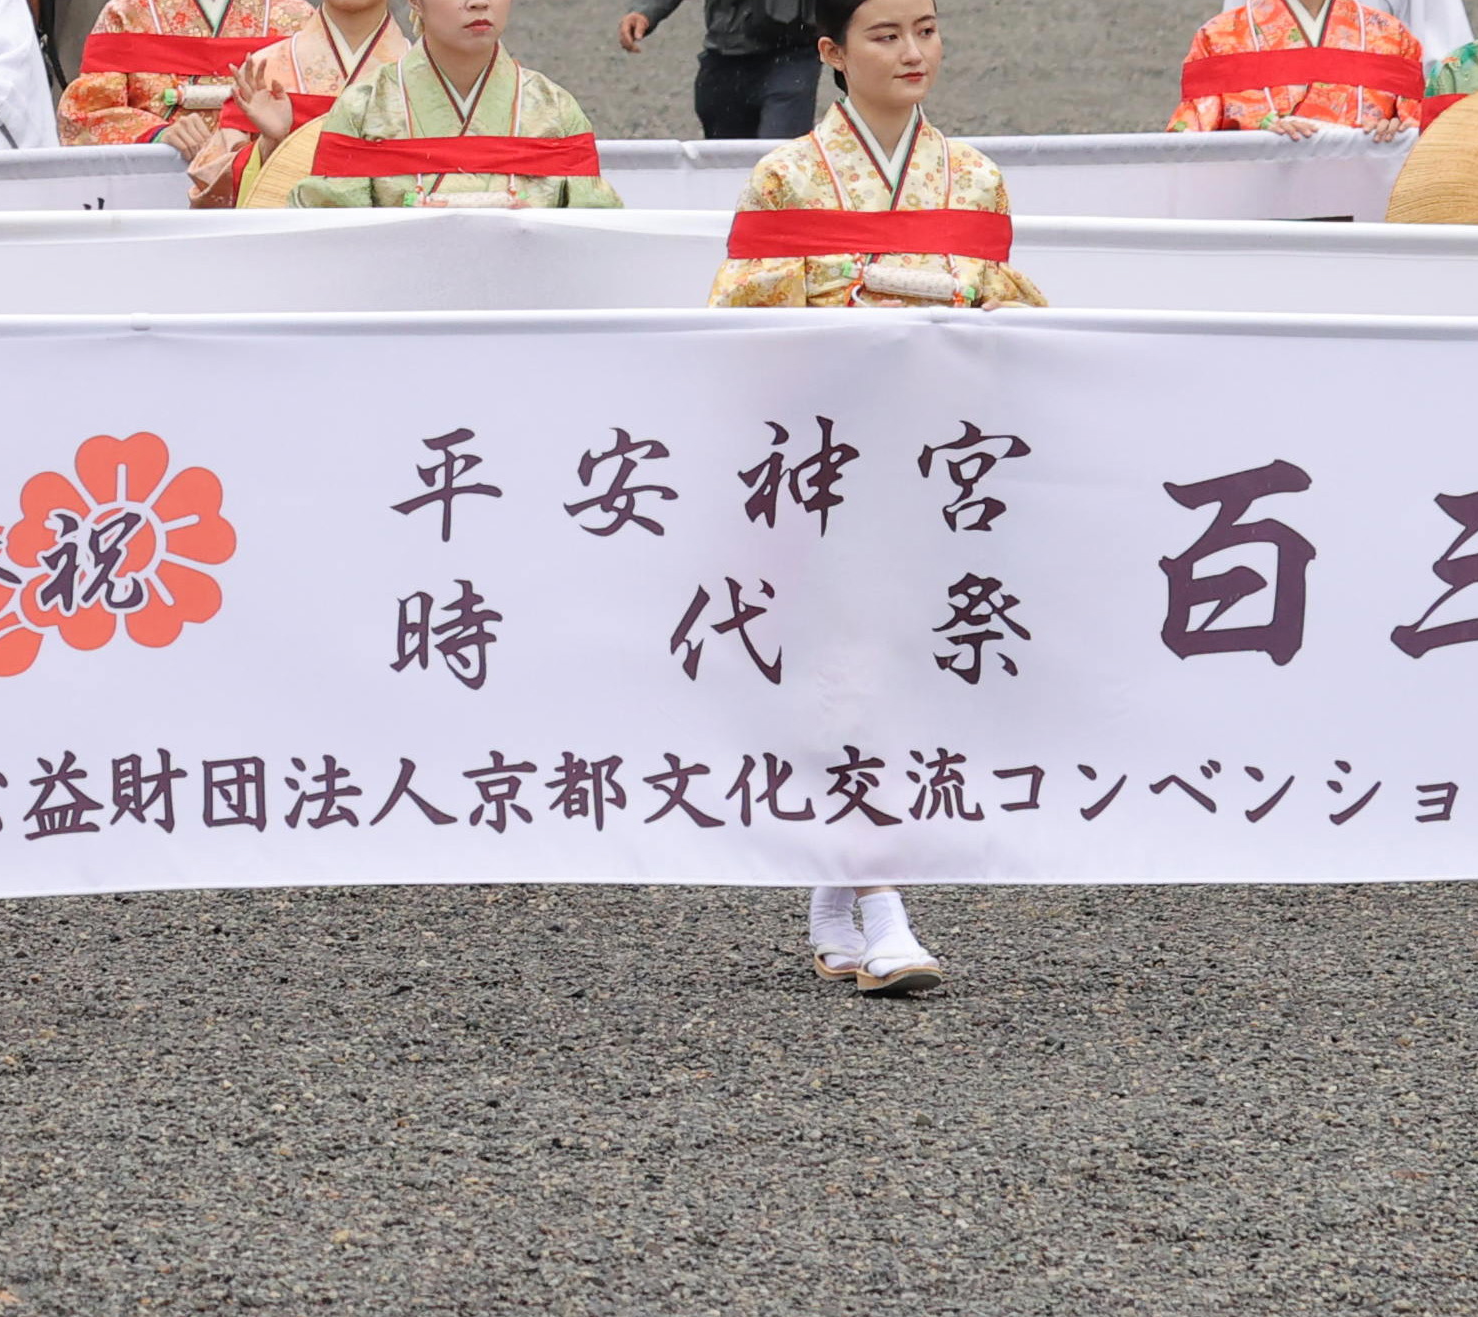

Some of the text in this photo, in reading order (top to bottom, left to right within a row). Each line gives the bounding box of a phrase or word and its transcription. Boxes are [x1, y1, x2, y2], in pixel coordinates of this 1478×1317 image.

[391, 415, 1032, 542] 平安神宮
[390, 572, 1031, 690] 時代祭
